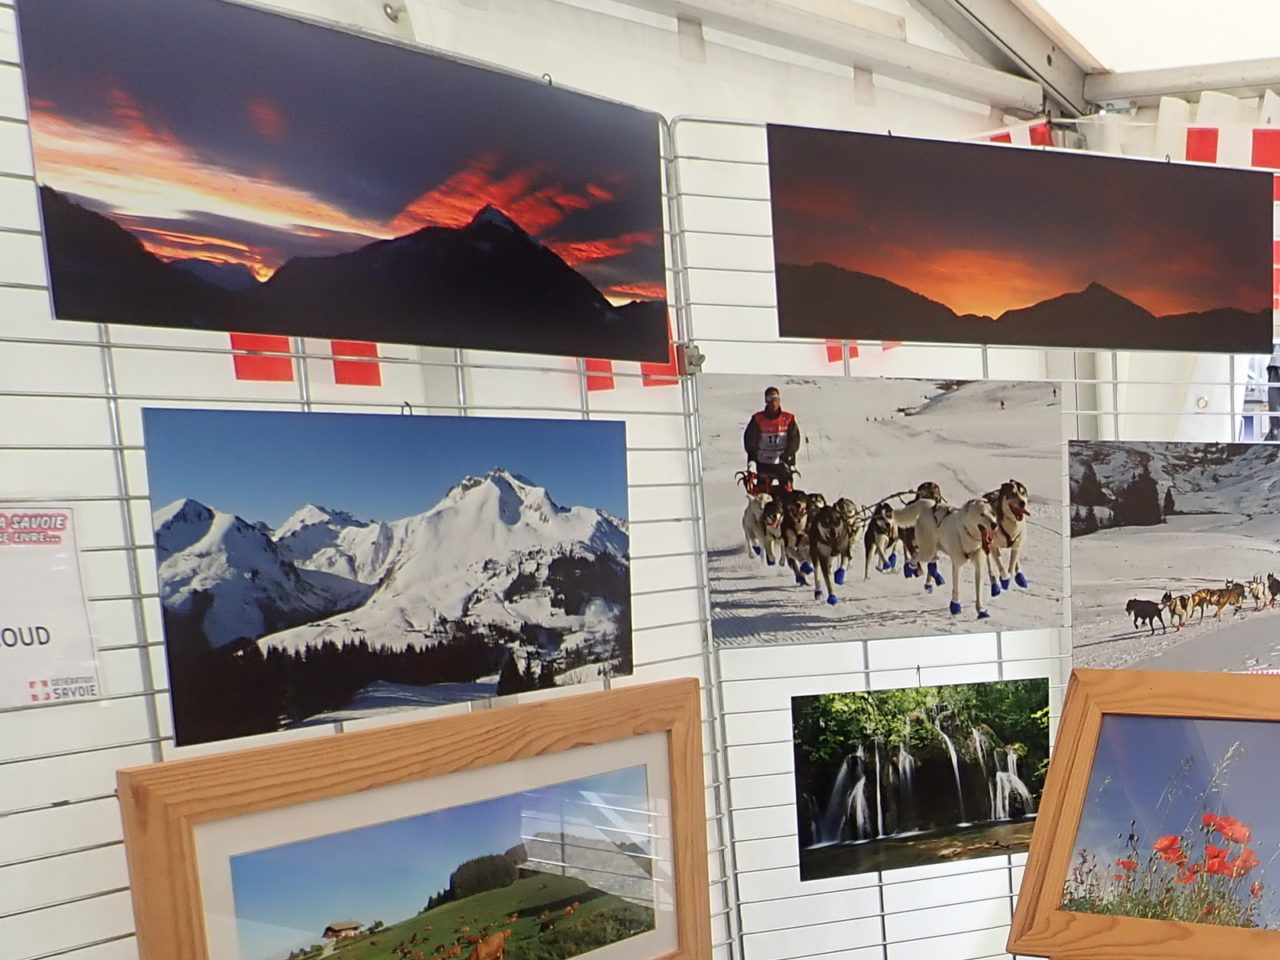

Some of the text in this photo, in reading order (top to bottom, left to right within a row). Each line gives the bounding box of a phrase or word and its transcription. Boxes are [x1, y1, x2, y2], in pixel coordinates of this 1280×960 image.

[12, 516, 65, 529] SAVOIE
[0, 625, 51, 648] OUD
[52, 685, 97, 700] SAVOIE
